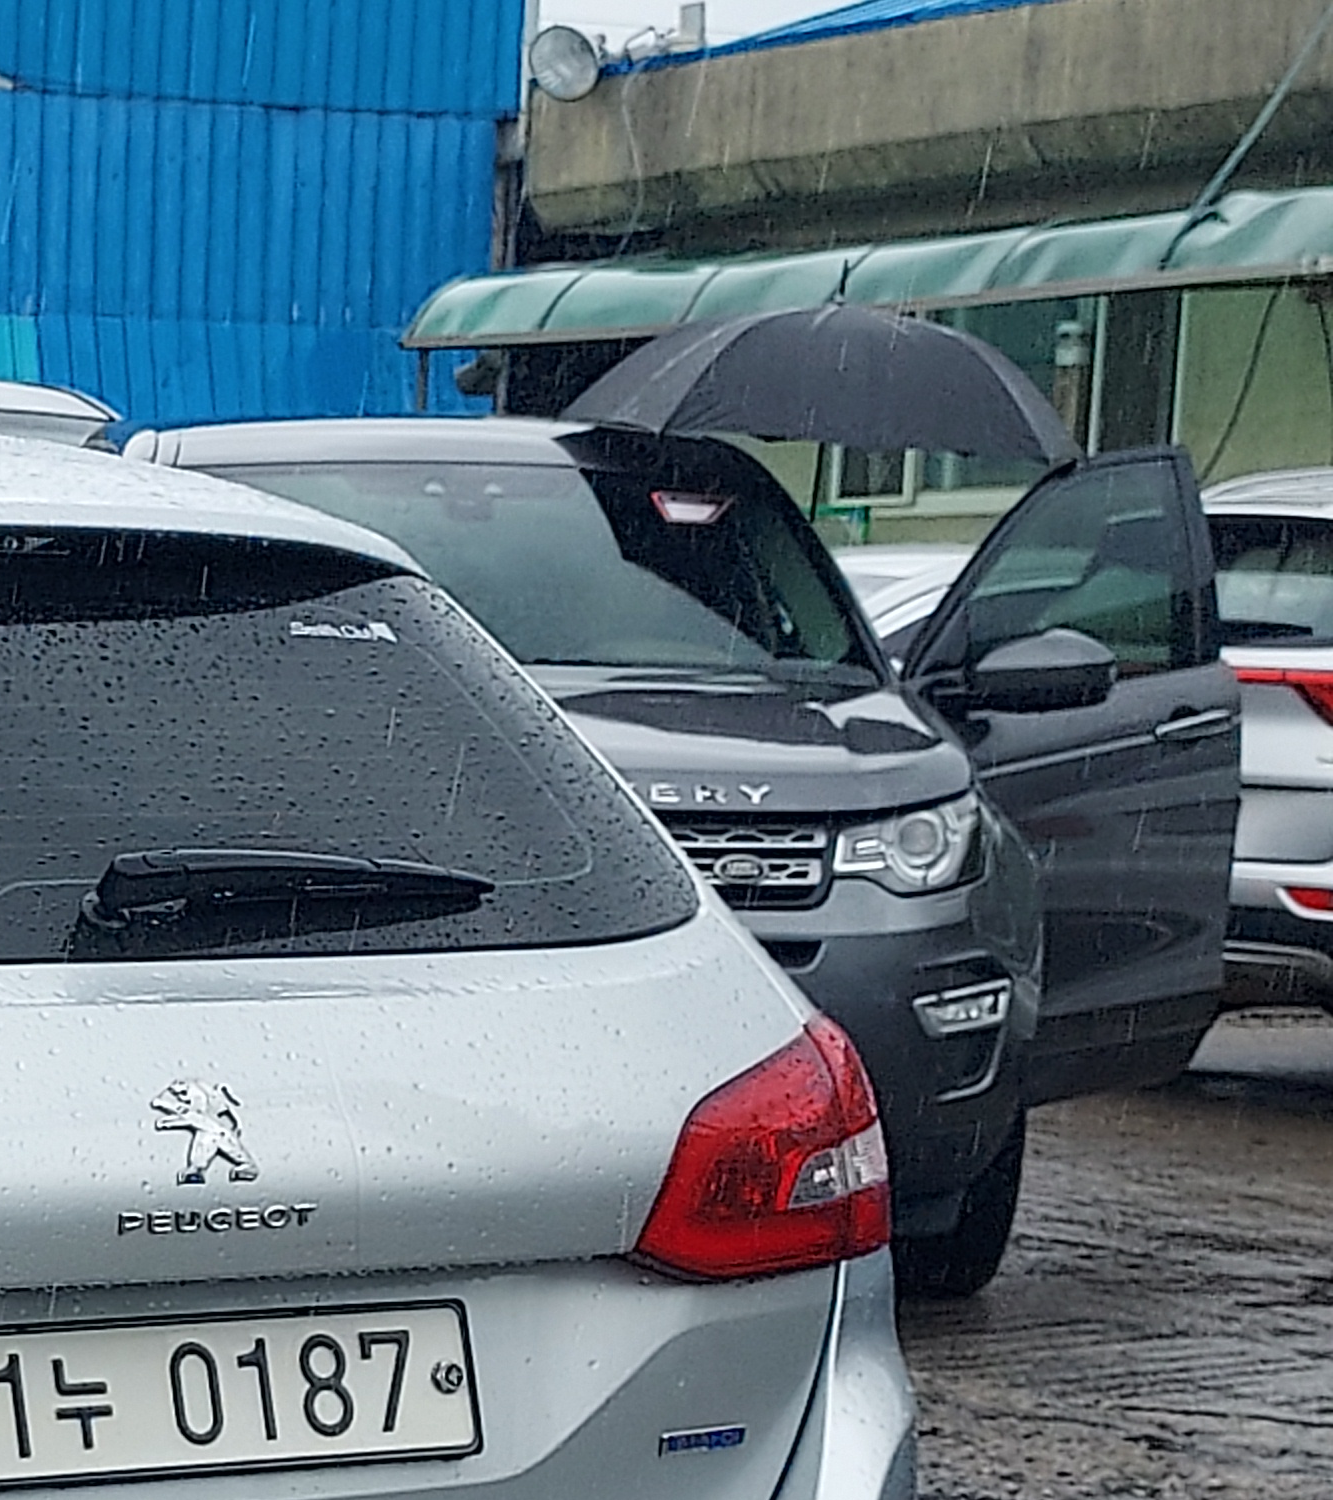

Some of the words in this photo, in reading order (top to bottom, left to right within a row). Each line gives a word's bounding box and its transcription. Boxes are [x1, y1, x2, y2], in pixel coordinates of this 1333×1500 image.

[627, 782, 771, 806] ERY
[117, 1204, 318, 1236] PEUGEOT
[169, 1329, 410, 1446] 0187
